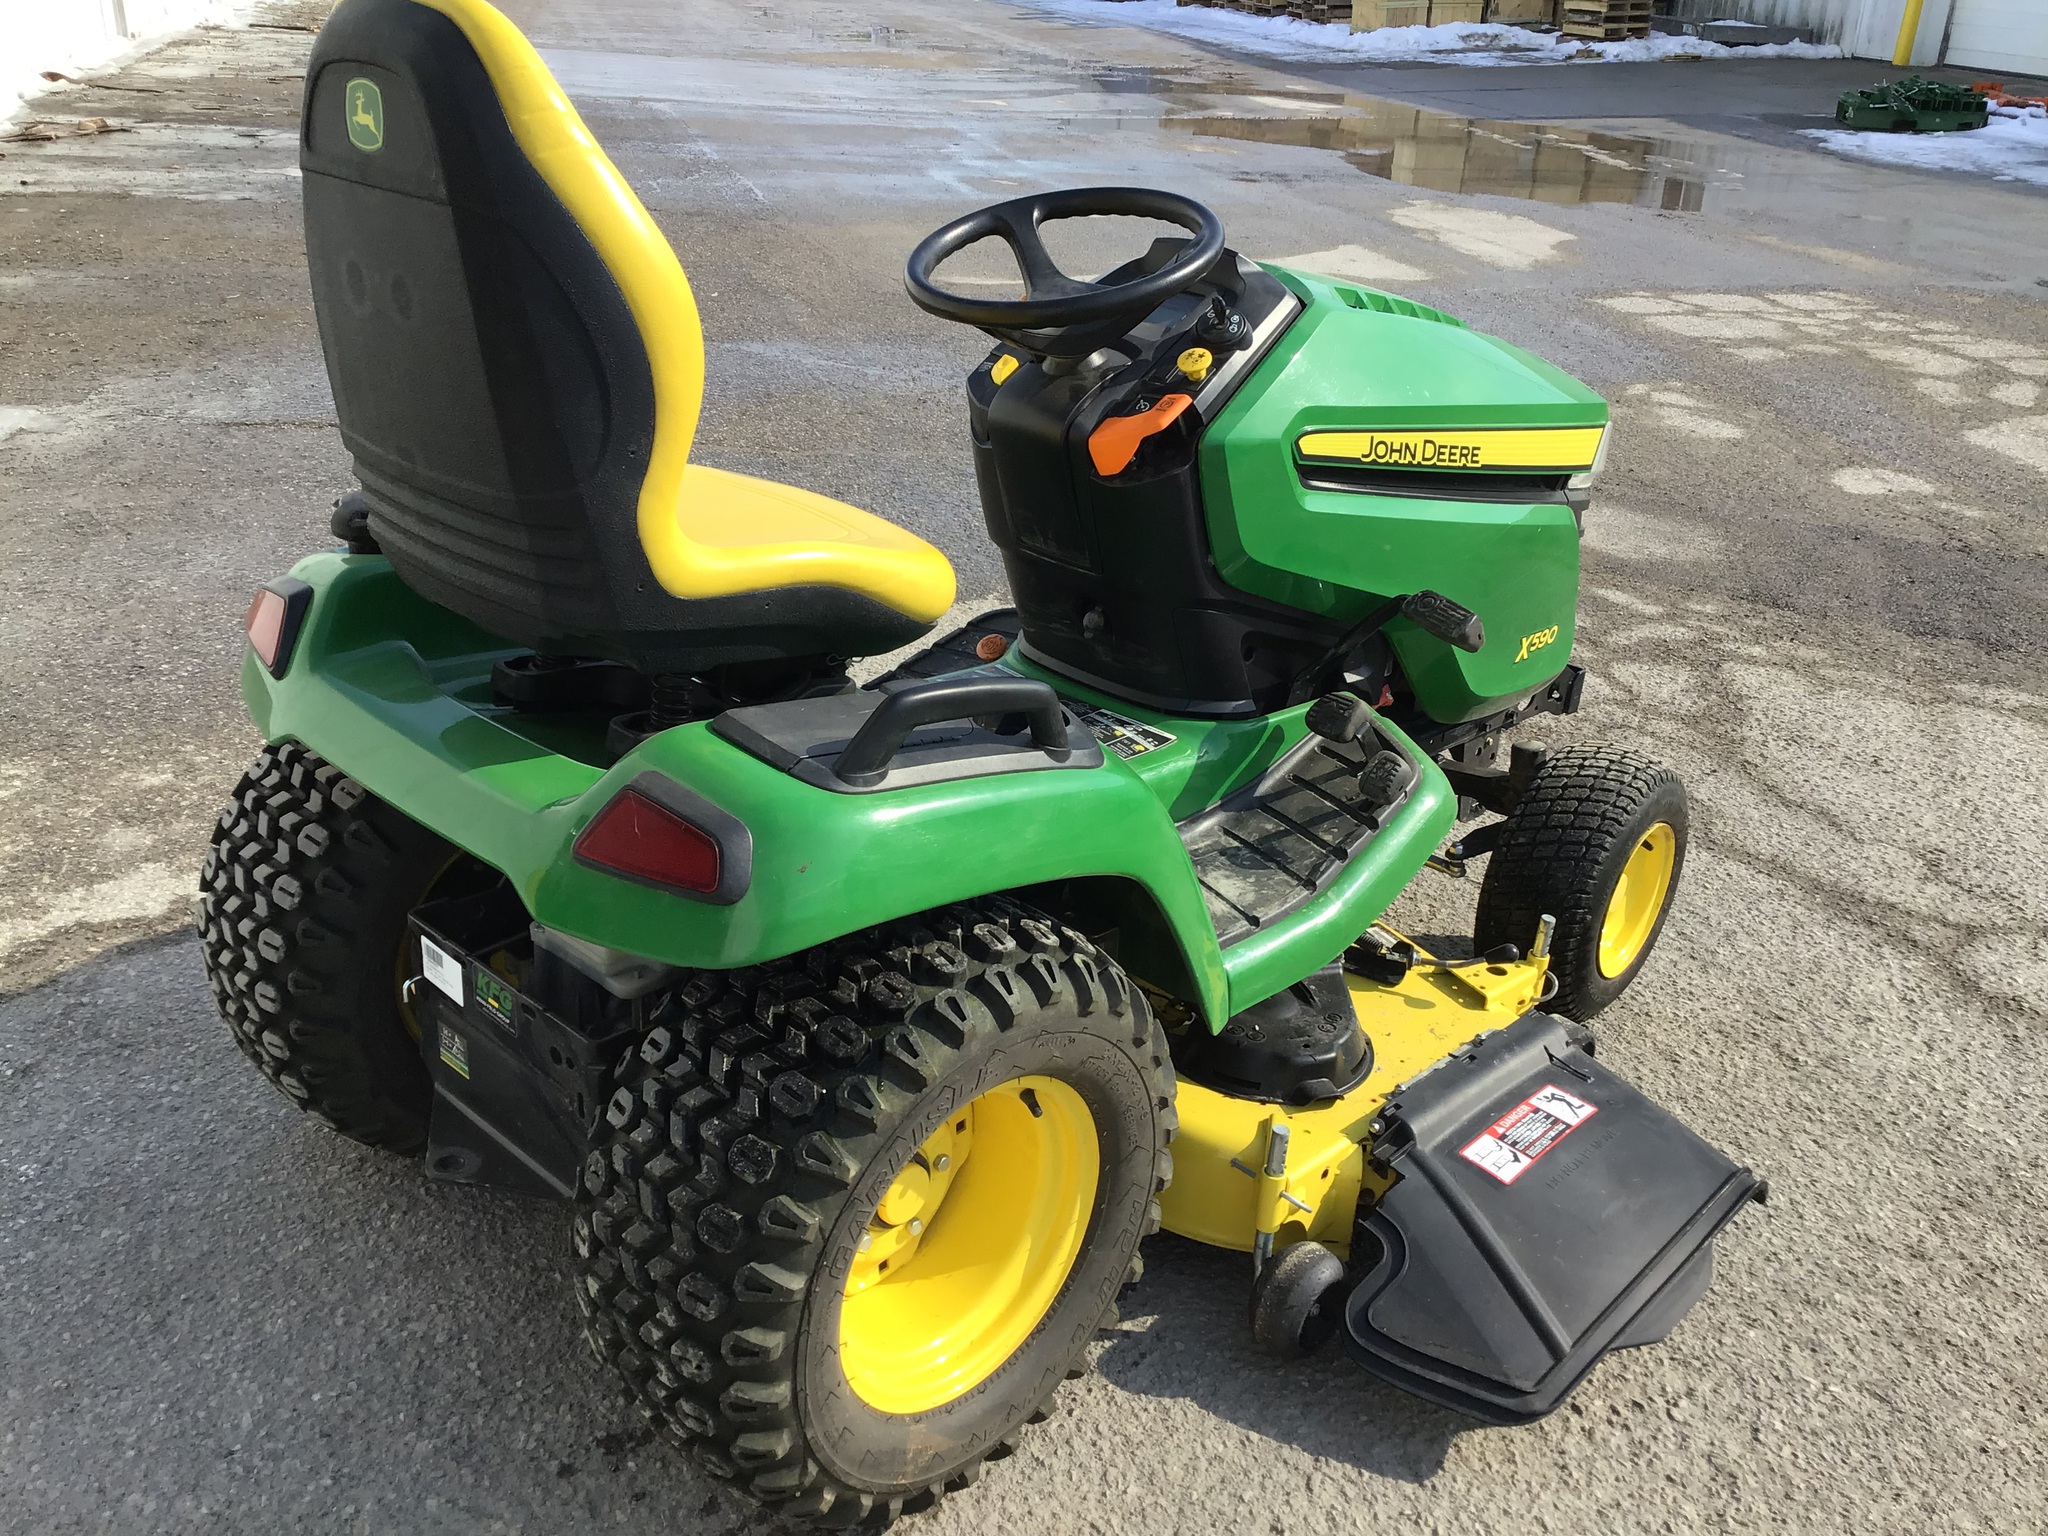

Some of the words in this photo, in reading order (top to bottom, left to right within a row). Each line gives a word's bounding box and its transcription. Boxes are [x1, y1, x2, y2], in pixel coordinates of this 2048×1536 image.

[1361, 435, 1417, 460] JOHN
[1421, 439, 1481, 464] DEERE
[1514, 624, 1558, 663] X590
[477, 972, 512, 1011] KFG
[1499, 1104, 1532, 1129] DANGER
